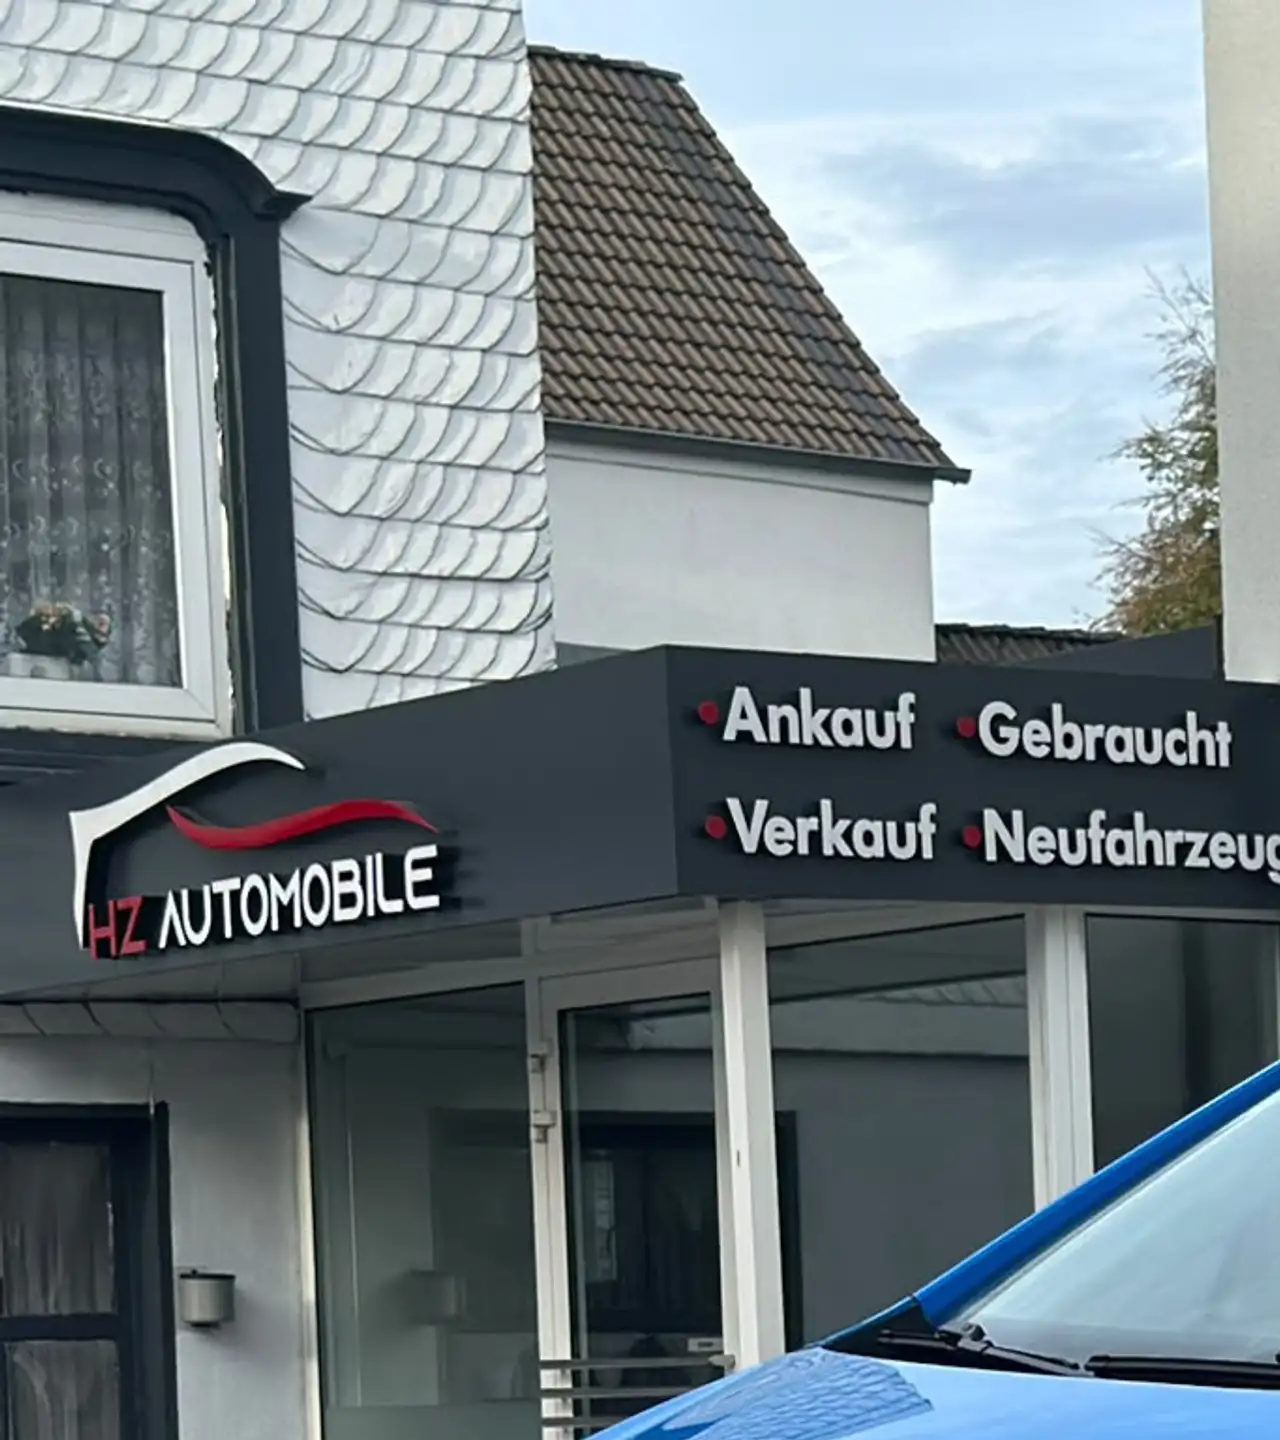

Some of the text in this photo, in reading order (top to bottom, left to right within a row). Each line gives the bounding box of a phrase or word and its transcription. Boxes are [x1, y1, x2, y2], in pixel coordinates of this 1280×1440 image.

[723, 687, 915, 750] Ankauf
[978, 701, 1232, 767] Gebraucht
[726, 798, 937, 860] Verkauf
[88, 844, 441, 960] HZ AUTOMOBILE
